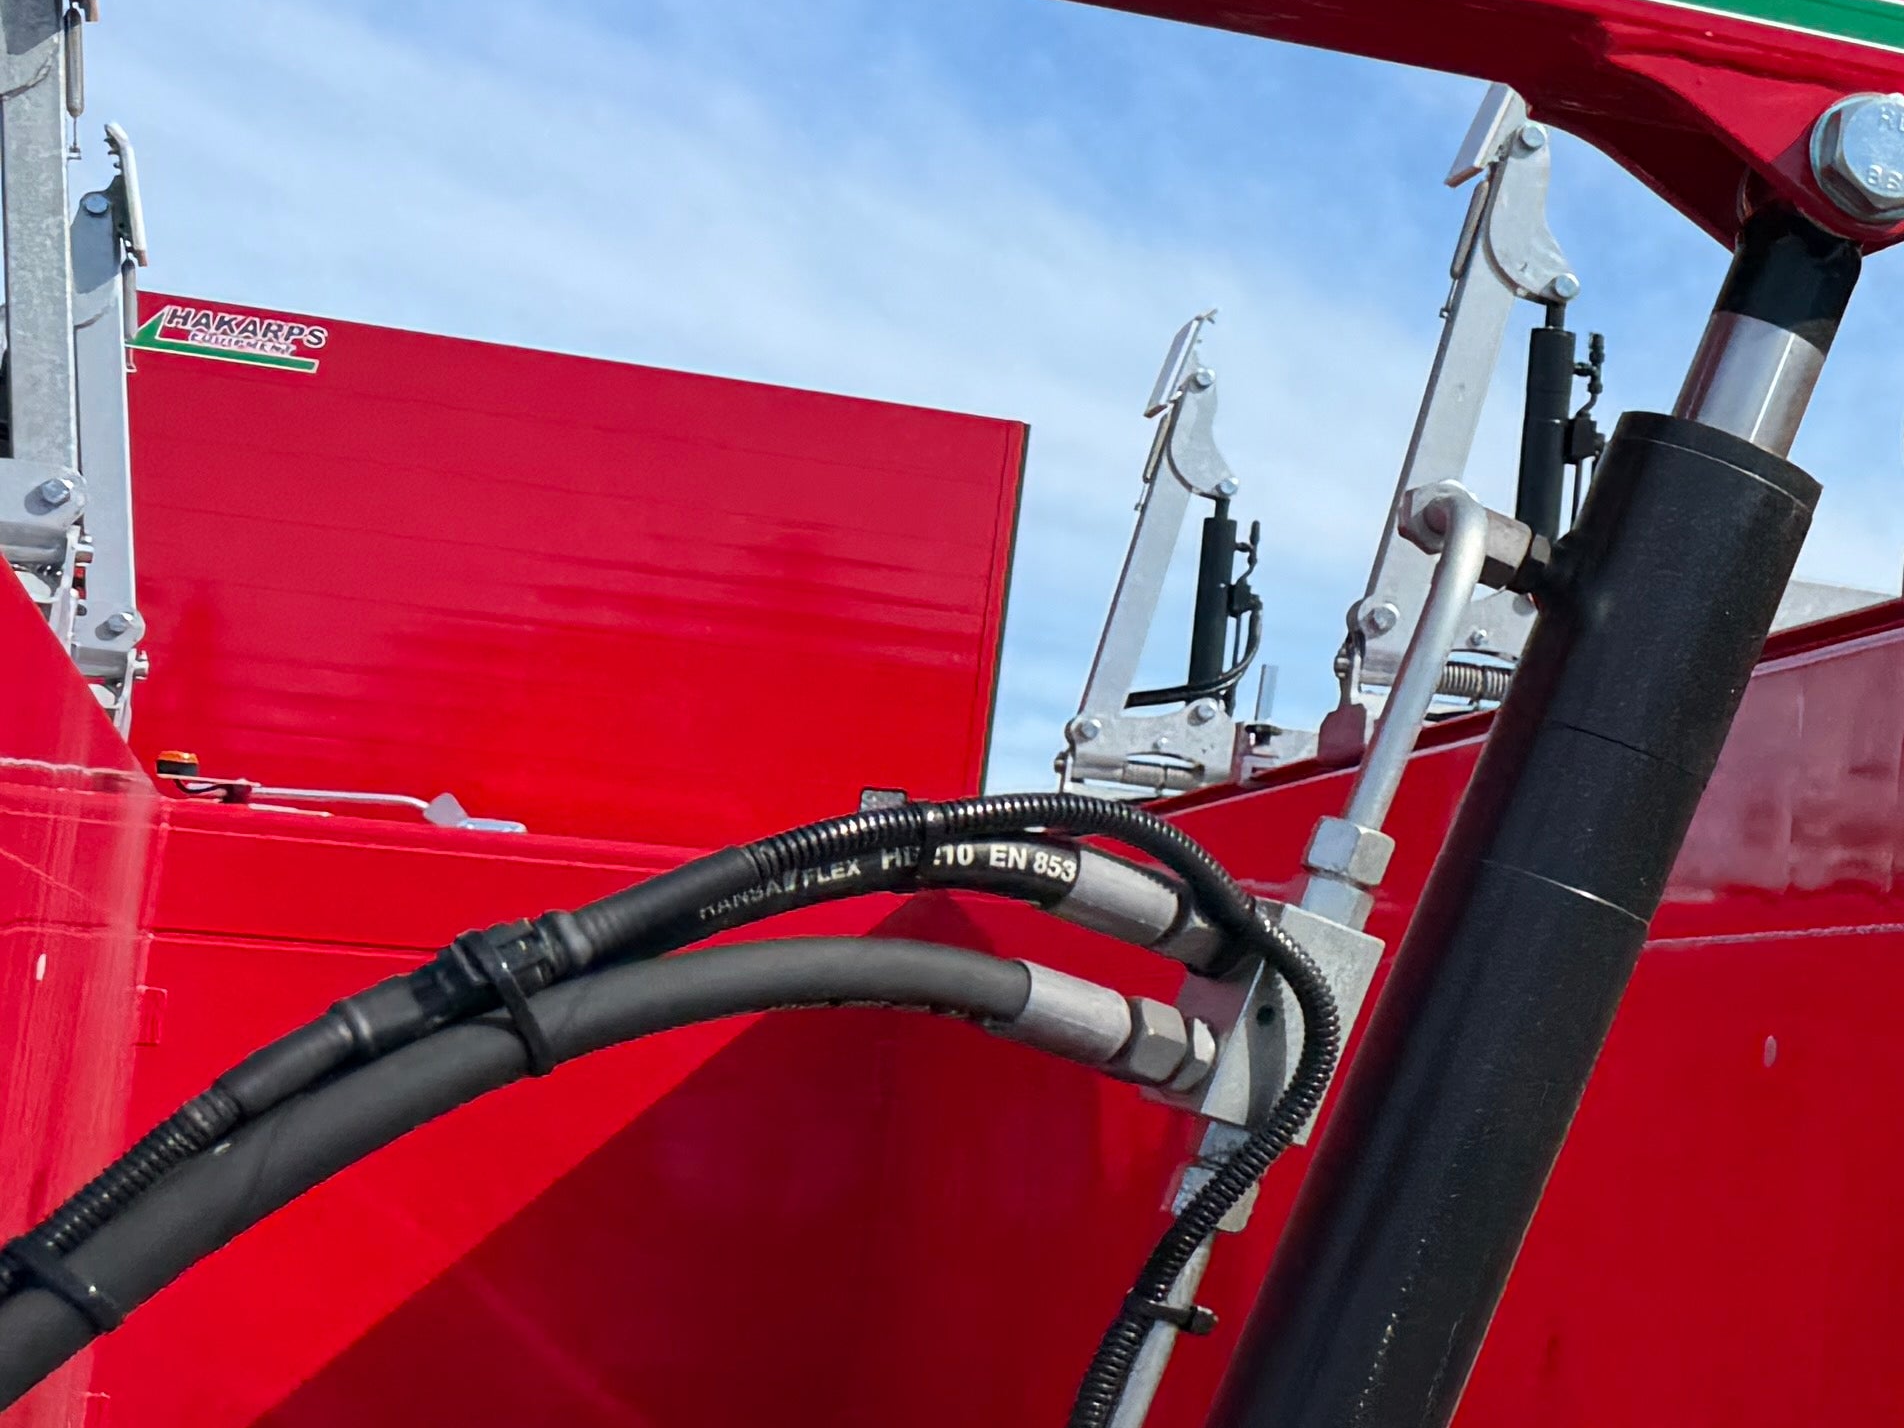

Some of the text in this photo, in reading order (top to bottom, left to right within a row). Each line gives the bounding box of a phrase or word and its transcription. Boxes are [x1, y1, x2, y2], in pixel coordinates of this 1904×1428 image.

[166, 306, 328, 348] HAKARPS
[989, 843, 1028, 871] EN
[1033, 850, 1078, 883] 853
